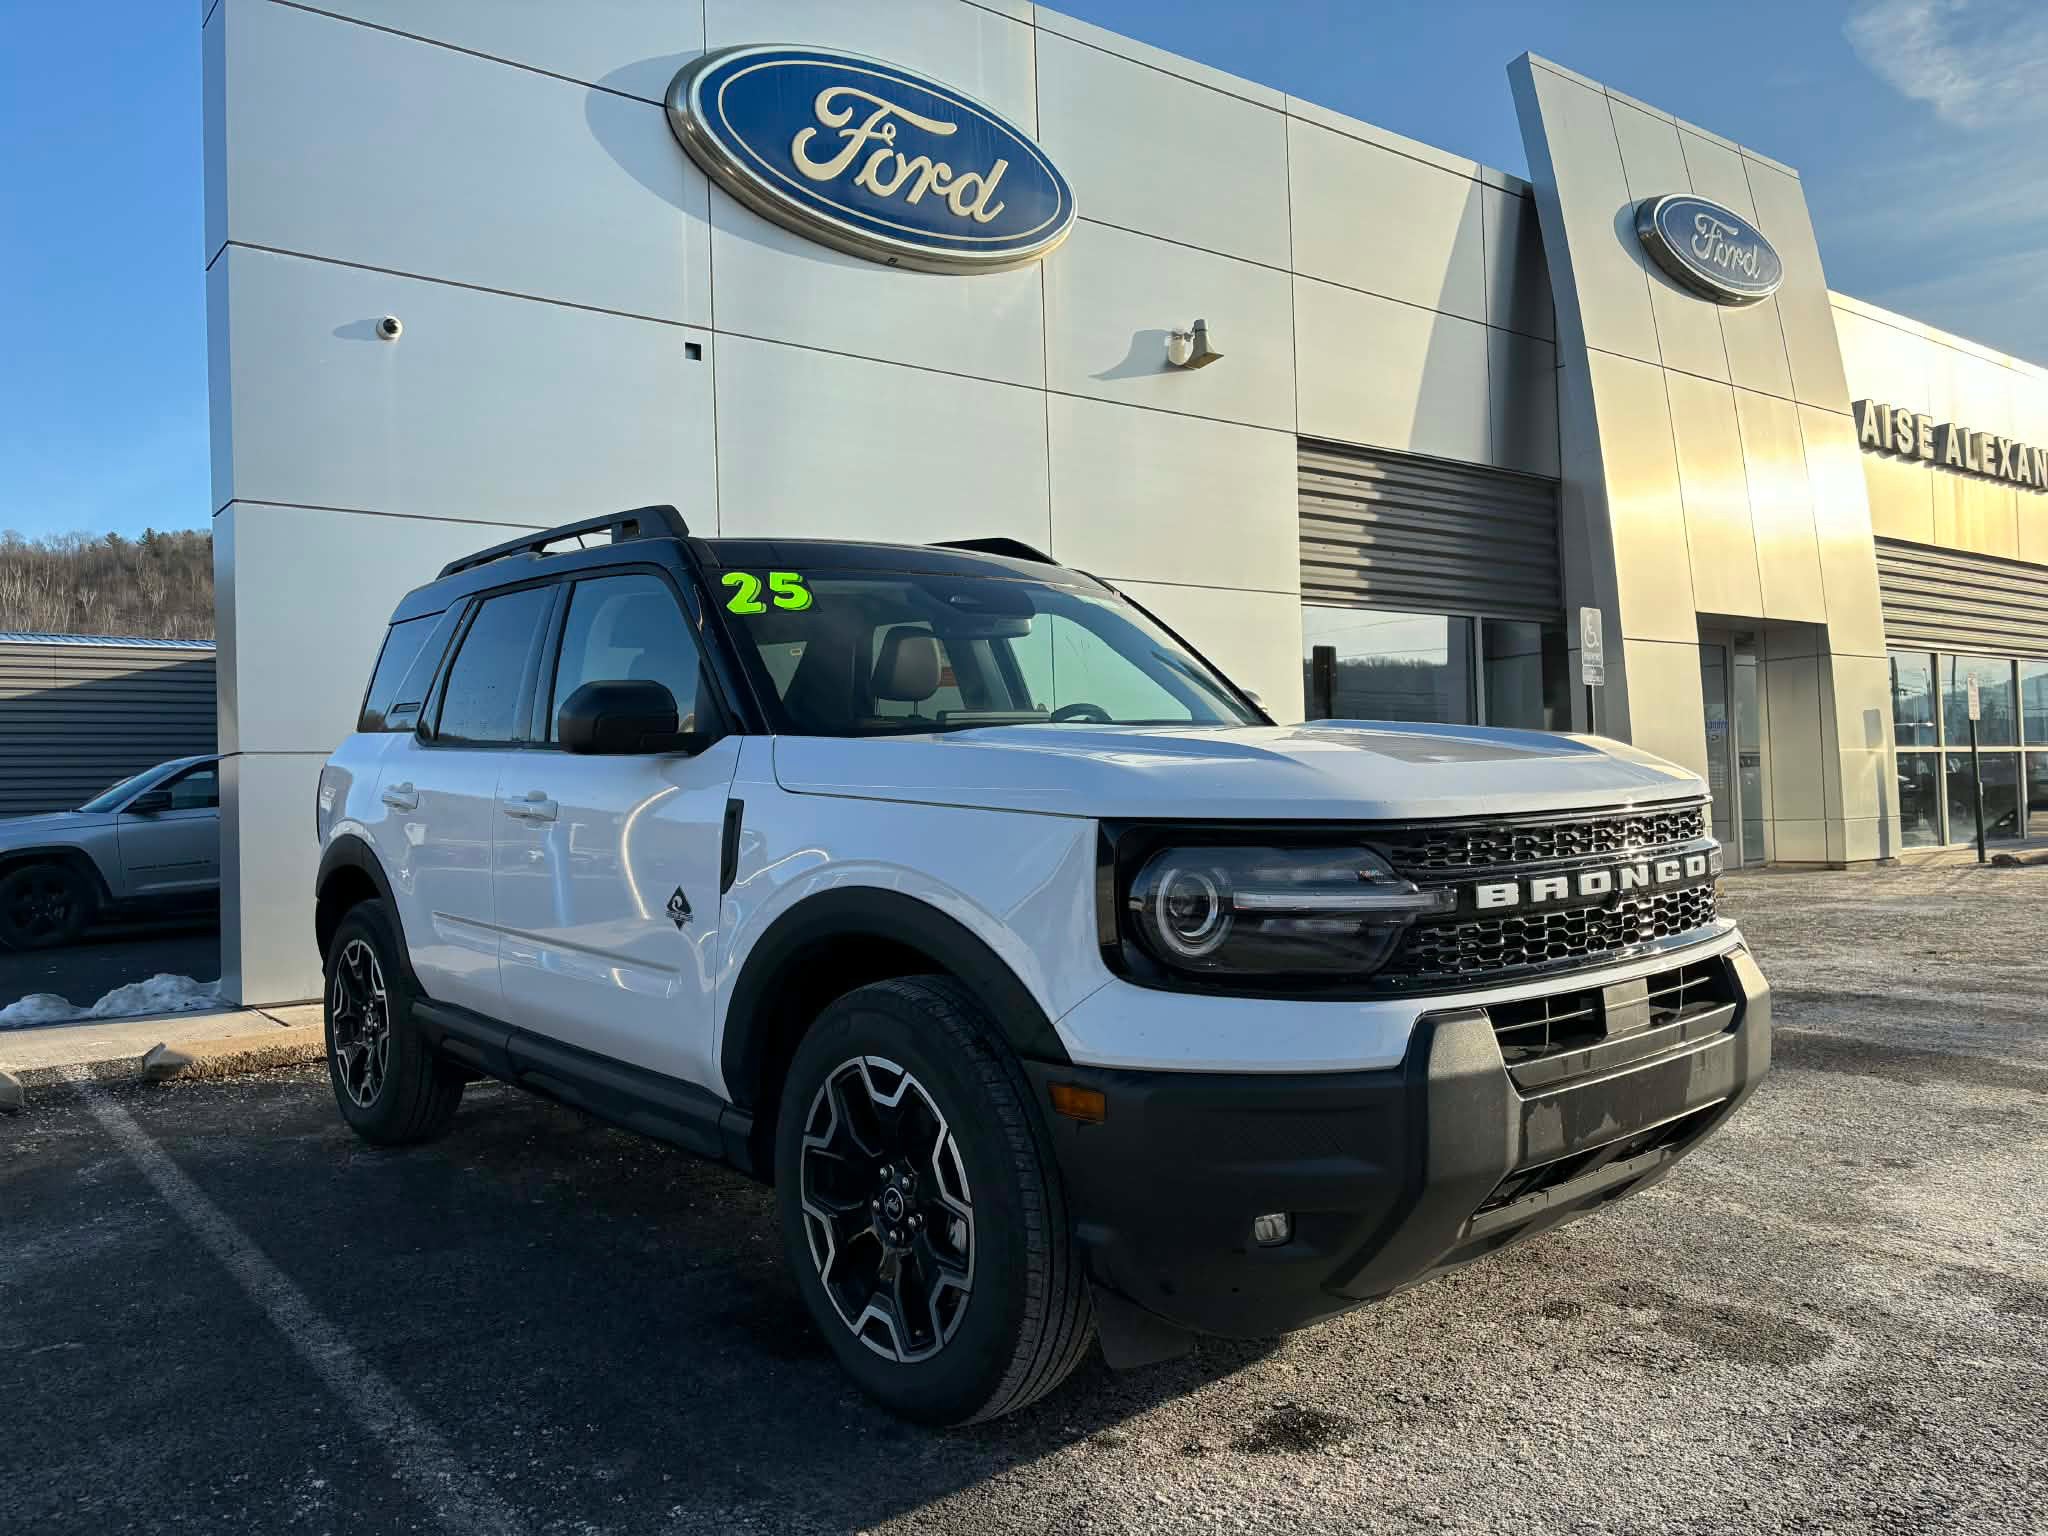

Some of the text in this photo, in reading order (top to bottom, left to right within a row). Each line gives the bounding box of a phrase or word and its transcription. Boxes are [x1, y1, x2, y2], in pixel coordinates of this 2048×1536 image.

[791, 85, 1009, 224] Ford
[1691, 212, 1761, 280] Ford
[1855, 398, 1935, 459] AISE
[721, 571, 813, 615] 25
[1476, 855, 1706, 910] BRONCO
